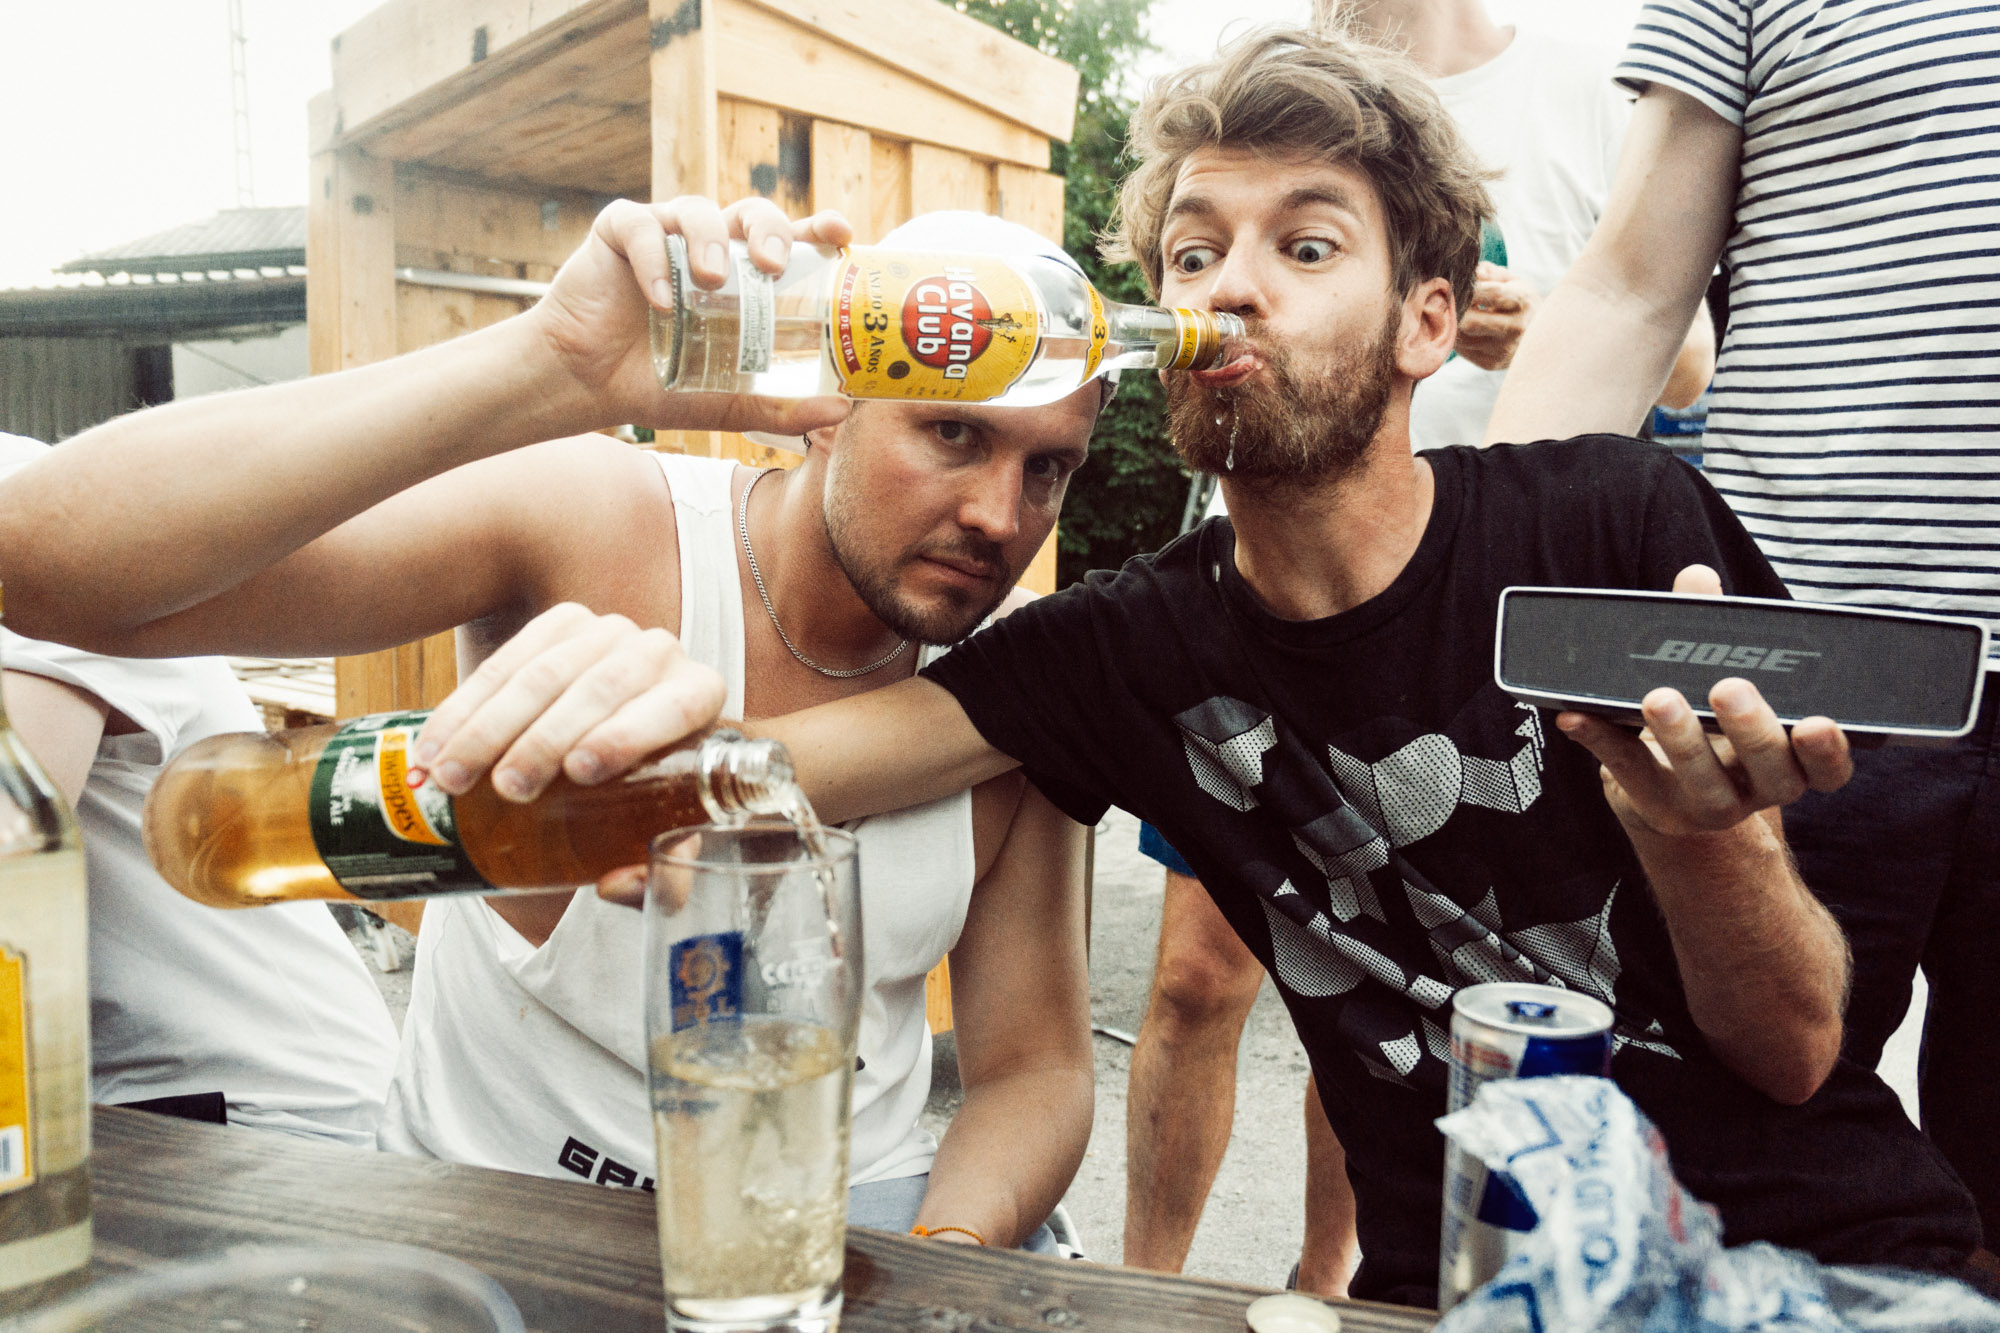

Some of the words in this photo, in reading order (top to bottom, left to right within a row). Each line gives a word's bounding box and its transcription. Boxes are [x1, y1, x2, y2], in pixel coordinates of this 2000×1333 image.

[846, 272, 855, 286] EL
[840, 288, 851, 310] RON
[840, 315, 849, 330] DE
[863, 312, 889, 333] 3
[916, 284, 948, 356] Club
[943, 266, 977, 380] Havana
[1094, 325, 1106, 339] 3
[840, 333, 855, 363] CUBA
[866, 335, 886, 374] AÑOS
[1630, 639, 1821, 673] BOSE
[384, 734, 417, 832] Shweppes
